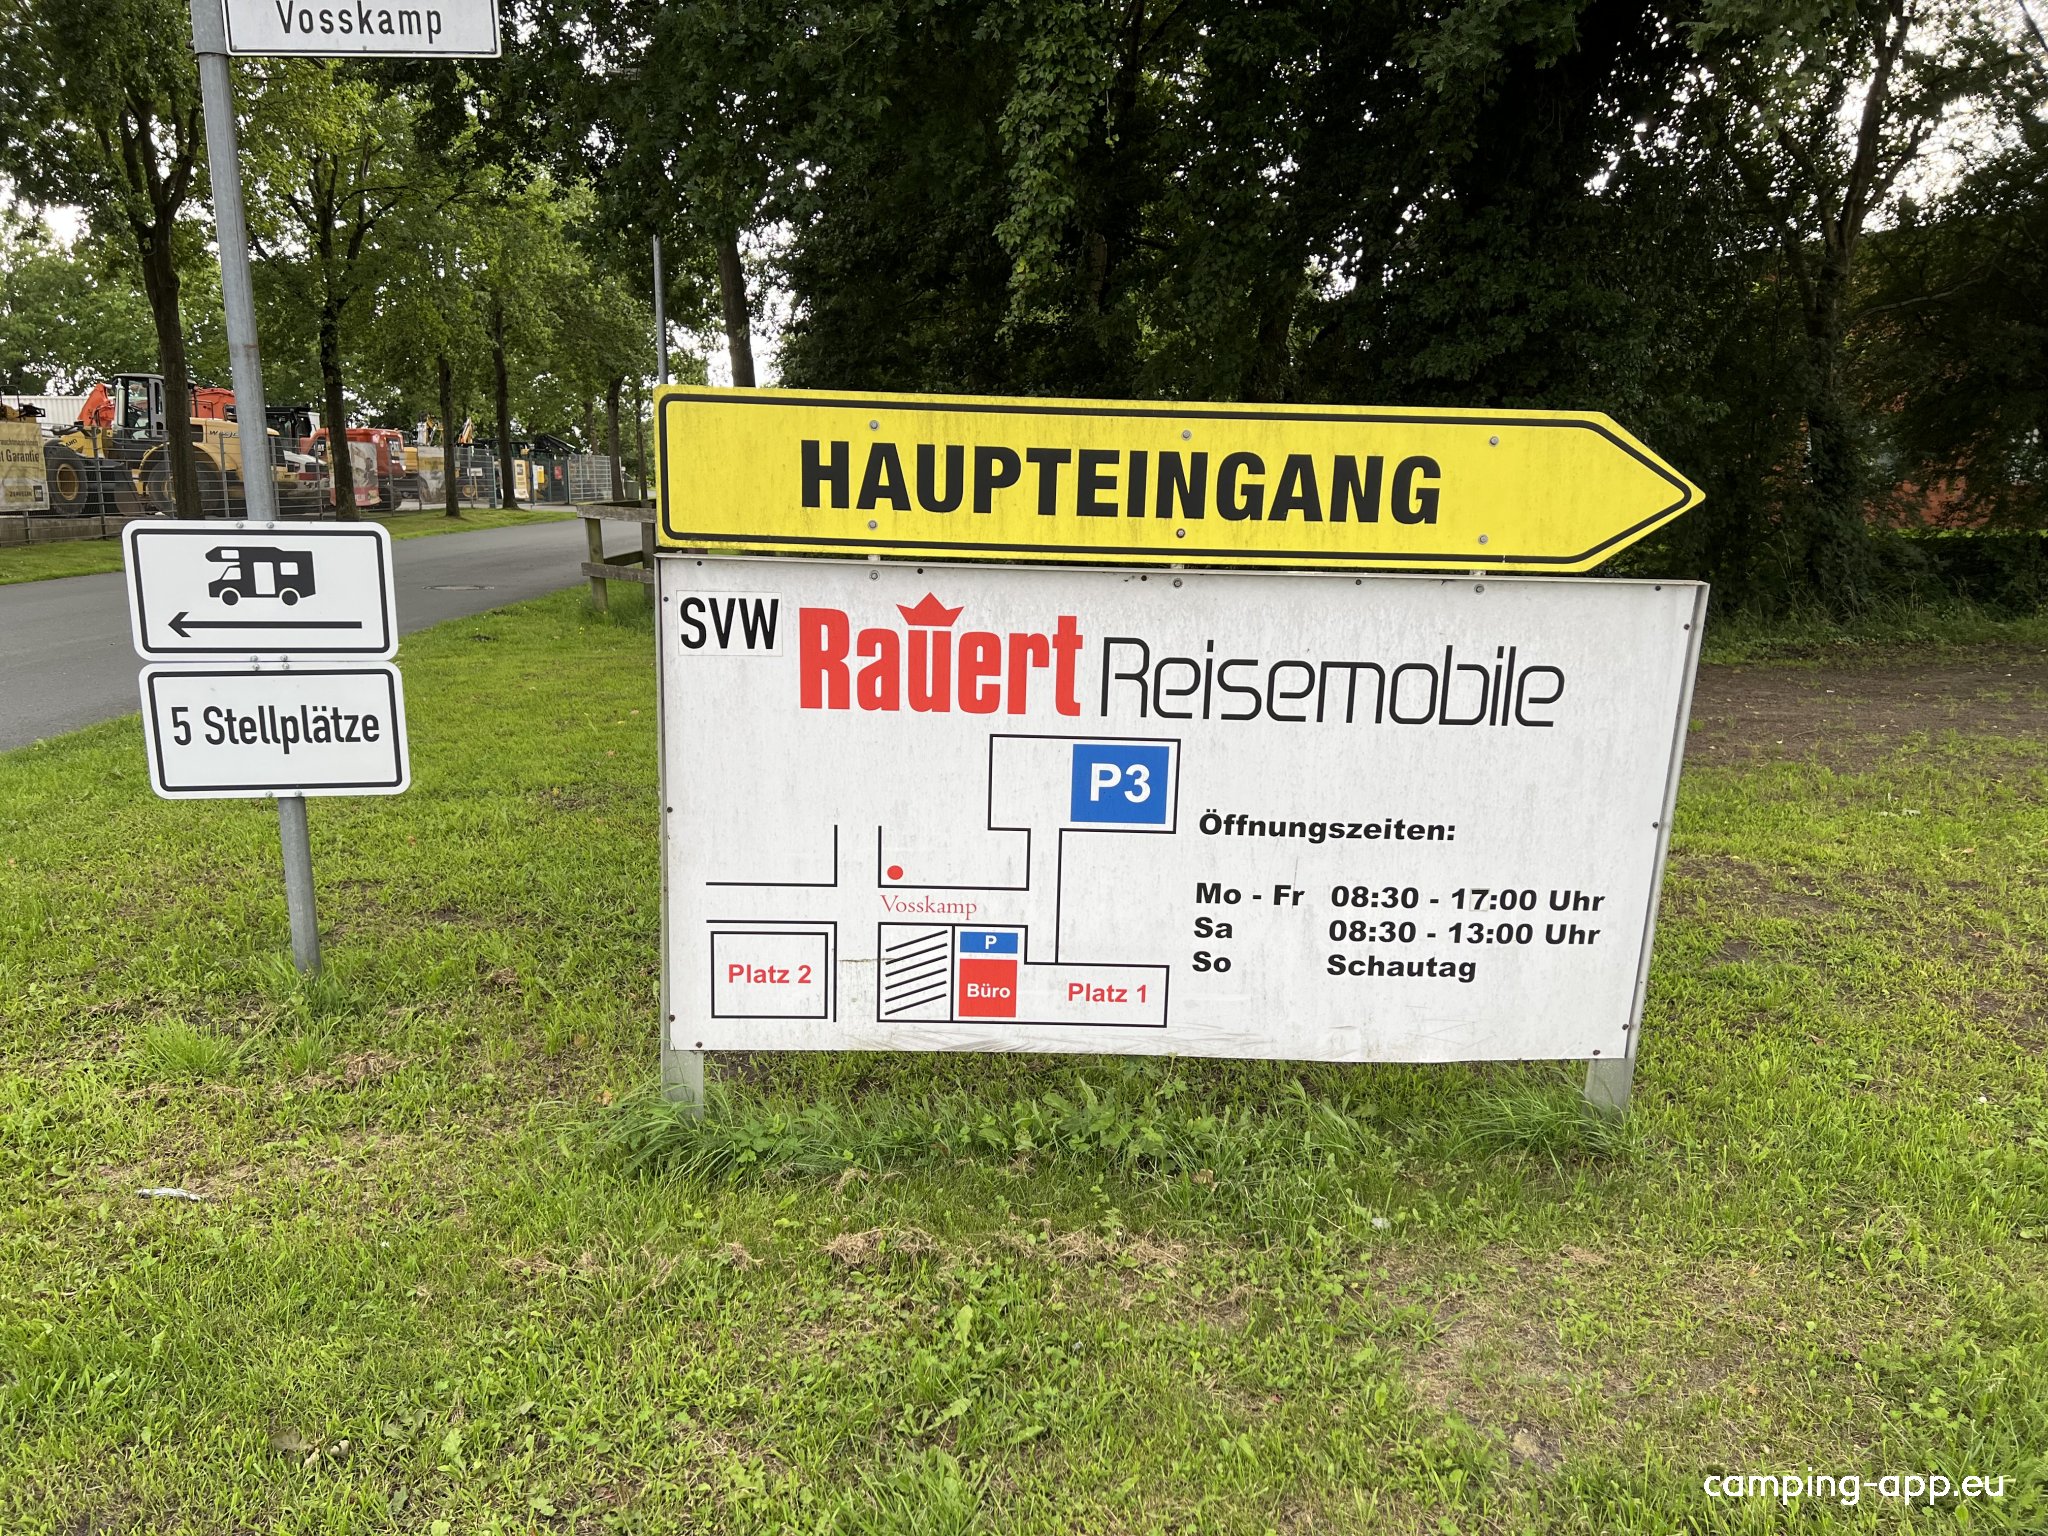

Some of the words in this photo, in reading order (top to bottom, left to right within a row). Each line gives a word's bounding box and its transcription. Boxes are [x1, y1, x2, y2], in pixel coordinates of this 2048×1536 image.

[275, 0, 442, 44] Vosskamp
[800, 439, 1442, 525] HAUPTEINGANG
[680, 597, 779, 650] SVW
[799, 605, 1084, 717] Rauert
[1100, 636, 1566, 728] Reisemobile
[171, 706, 192, 746] 5
[203, 704, 380, 755] Stellplätze
[1089, 762, 1151, 803] P3
[1199, 808, 1456, 844] Öffnungszeiten:
[880, 894, 978, 921] Vosskamp
[1195, 882, 1242, 905] Mo
[1273, 884, 1306, 906] Fr
[1331, 885, 1420, 909] 08:30
[1451, 887, 1538, 911] 17:00
[1549, 889, 1606, 912] Uhr
[984, 935, 998, 950] P
[1193, 916, 1233, 939] Sa
[1329, 919, 1417, 943] 08:30
[1448, 922, 1534, 945] 13:00
[1545, 923, 1602, 945] Uhr
[728, 963, 790, 984] Platz
[797, 964, 812, 984] 2
[1191, 950, 1232, 973] So
[1326, 954, 1477, 984] Schautag
[966, 982, 1011, 999] Büro
[1067, 982, 1128, 1003] Platz
[1136, 984, 1147, 1003] 1
